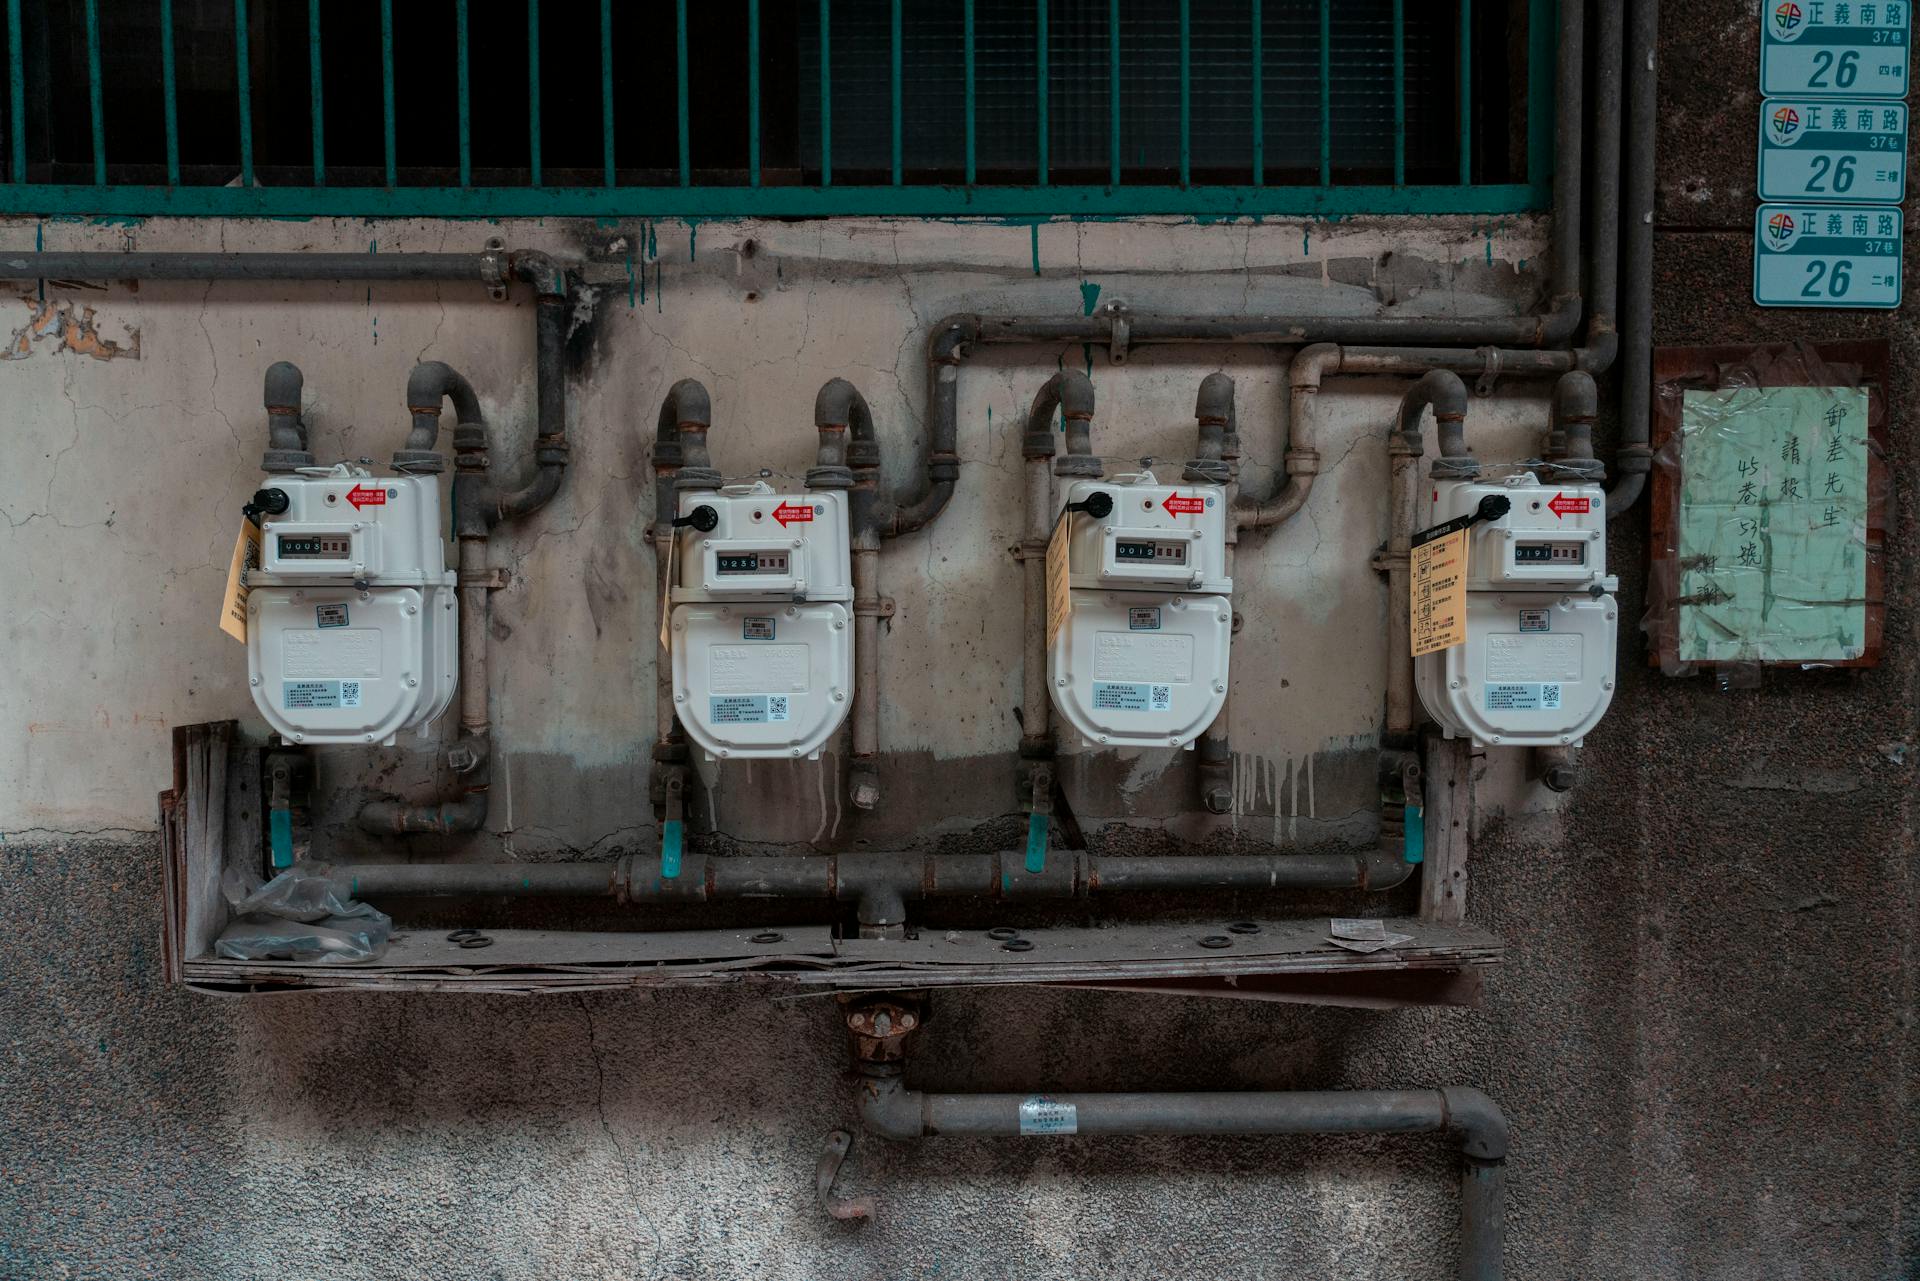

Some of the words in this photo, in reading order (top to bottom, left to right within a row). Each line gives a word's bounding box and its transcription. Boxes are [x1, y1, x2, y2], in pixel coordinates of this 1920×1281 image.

[1808, 2, 1902, 26] 正義南路
[1872, 31, 1902, 44] 37巷
[1807, 50, 1860, 89] 26
[1805, 106, 1898, 131] 正義南路
[1804, 155, 1857, 193] 26
[1801, 212, 1893, 236] 正義南路
[1865, 241, 1894, 254] 37巷
[1801, 260, 1853, 298] 26
[1780, 437, 1803, 501] 請投
[1823, 403, 1848, 528] 郵差先生
